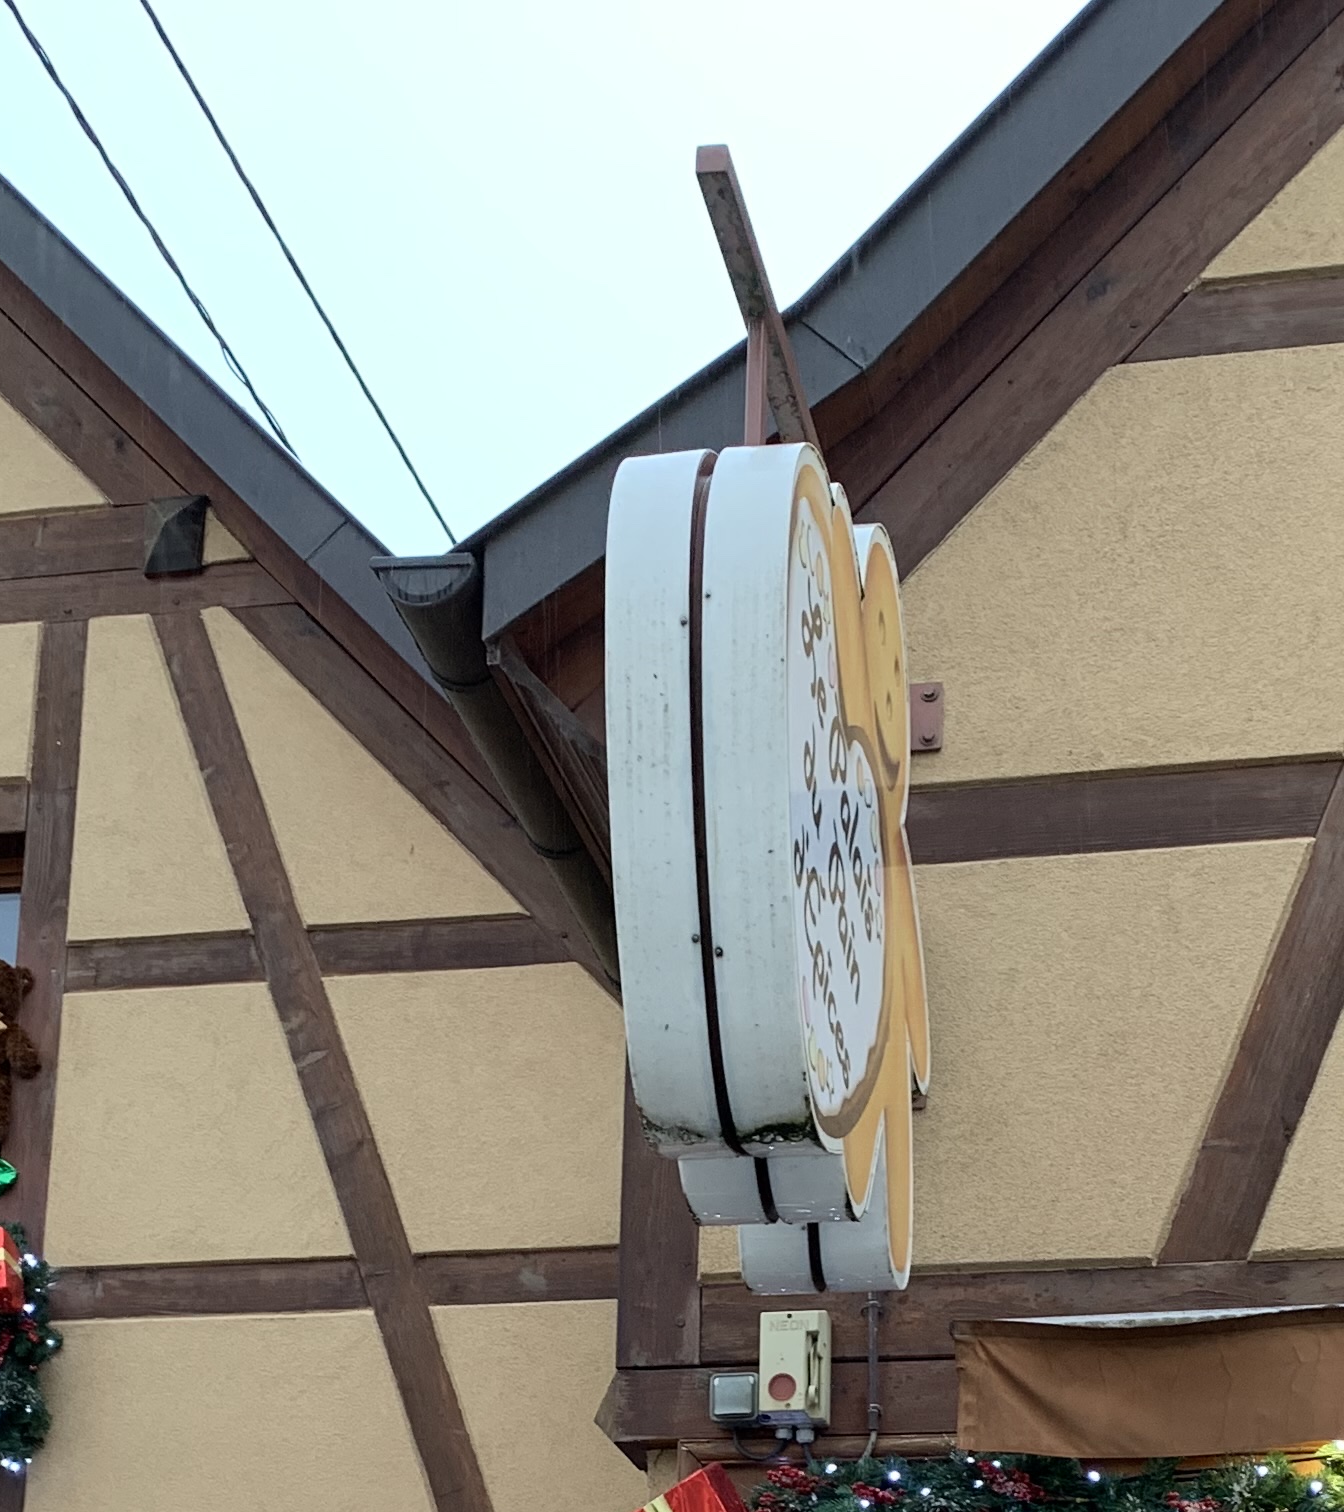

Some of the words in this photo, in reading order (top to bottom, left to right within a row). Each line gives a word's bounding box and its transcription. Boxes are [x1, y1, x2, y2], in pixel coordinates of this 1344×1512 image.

[803, 722, 823, 840] du
[828, 818, 861, 1005] Pain
[829, 690, 873, 943] Palais
[768, 1320, 810, 1332] NEON
